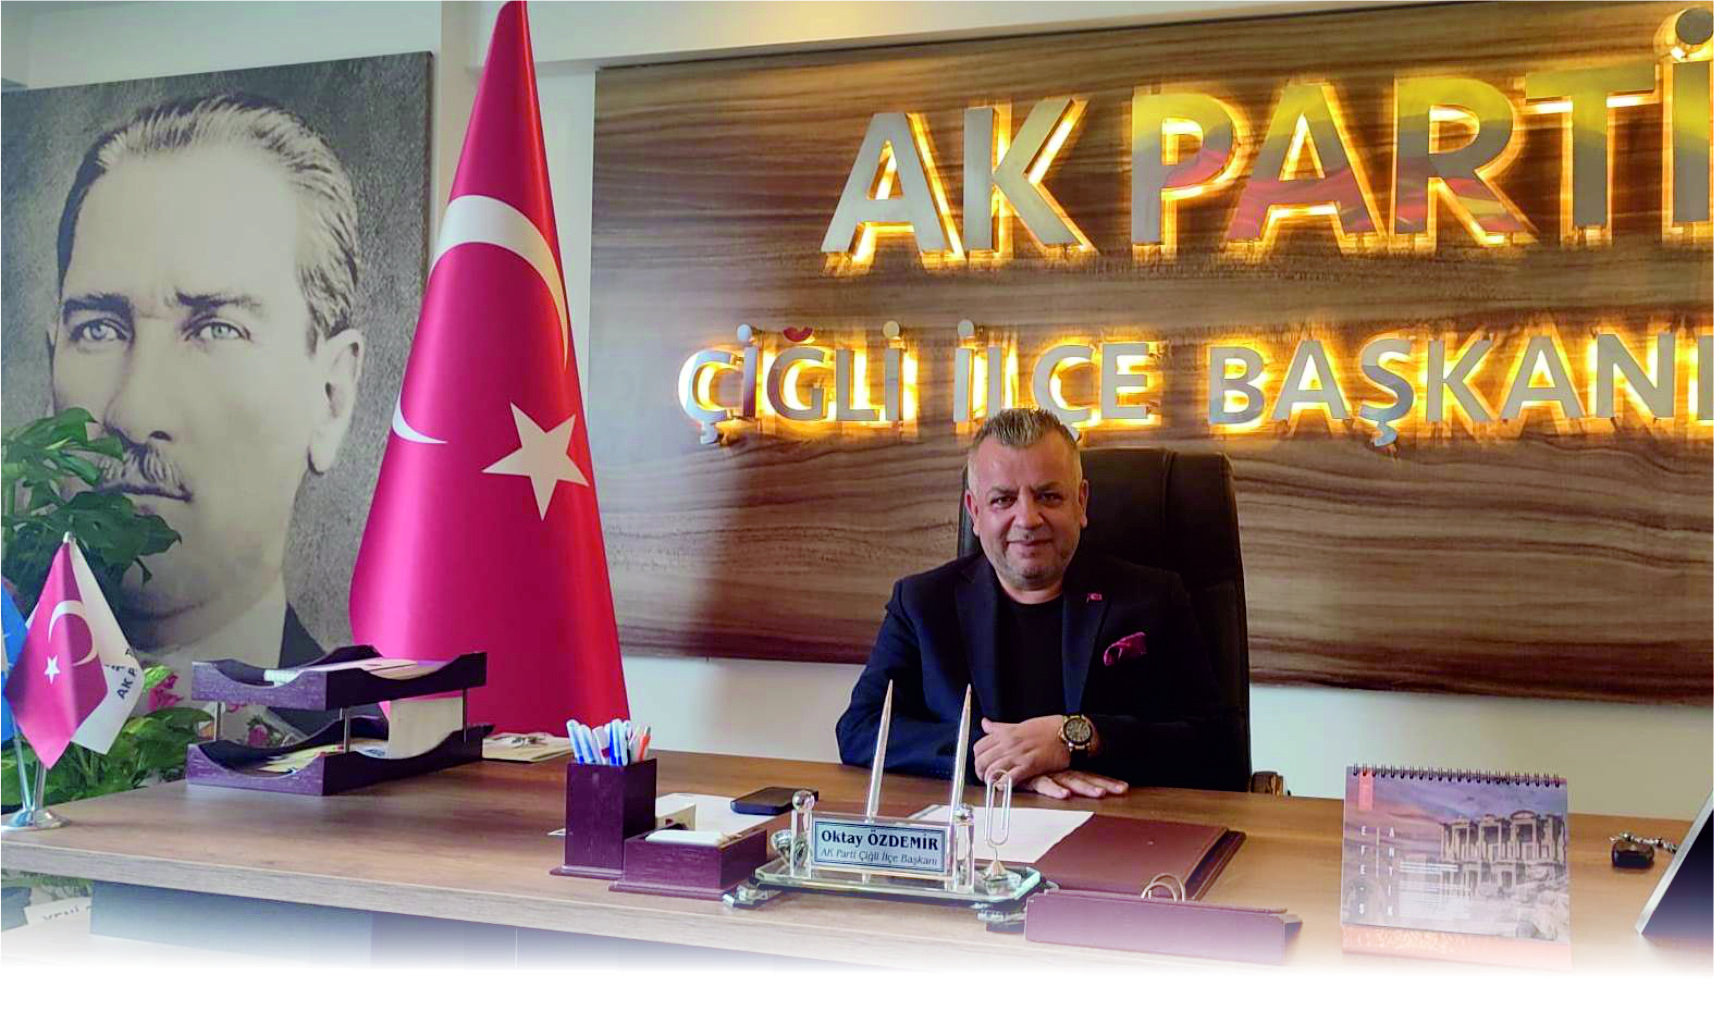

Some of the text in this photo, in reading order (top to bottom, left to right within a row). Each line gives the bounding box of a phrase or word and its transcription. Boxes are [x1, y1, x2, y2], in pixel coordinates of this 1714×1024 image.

[820, 7, 1713, 254] AK PARTİ
[679, 320, 901, 443] ÇİĞLİ
[822, 829, 938, 850] Oktay ÖZDEMİR
